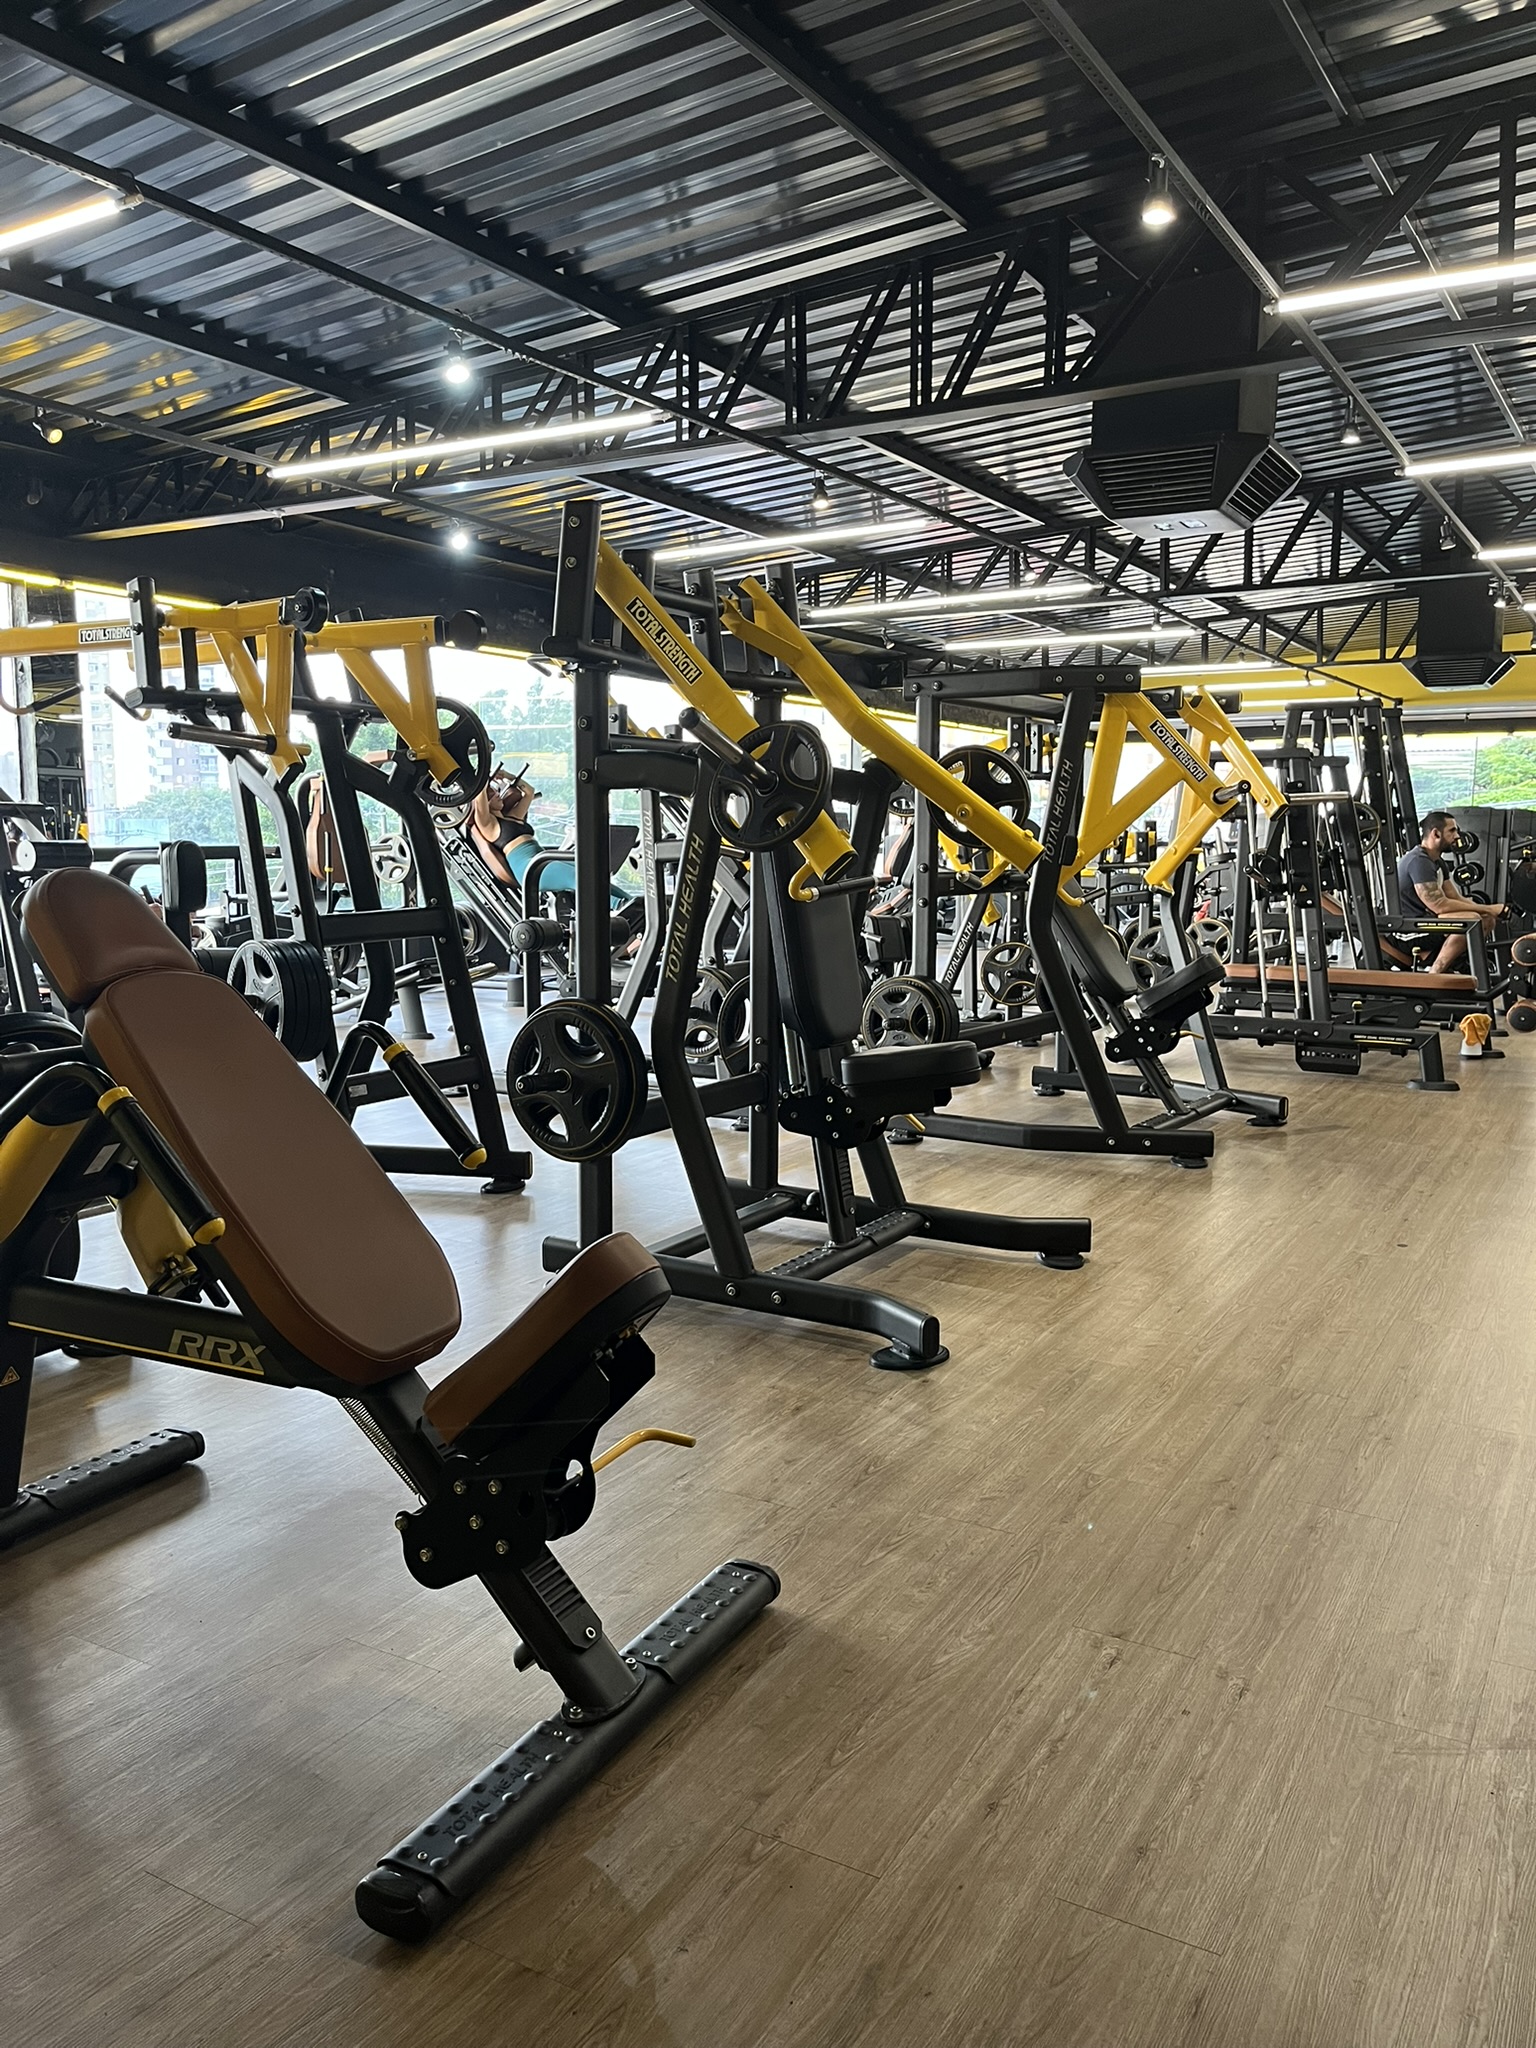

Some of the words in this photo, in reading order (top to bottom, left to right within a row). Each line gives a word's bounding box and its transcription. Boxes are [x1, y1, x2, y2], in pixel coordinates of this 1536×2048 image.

[643, 810, 654, 847] TOTAL
[1042, 820, 1061, 863] TOTAL
[1053, 759, 1074, 818] HEALTH
[645, 849, 656, 899] HEALTH
[665, 922, 688, 983] TOTAL
[679, 832, 705, 919] HEALTH
[944, 957, 961, 984] TOTAL
[955, 921, 975, 956] HEALTH
[168, 1329, 266, 1371] RRX
[442, 1800, 491, 1838] TOTAL
[488, 1752, 542, 1798] HEALTH
